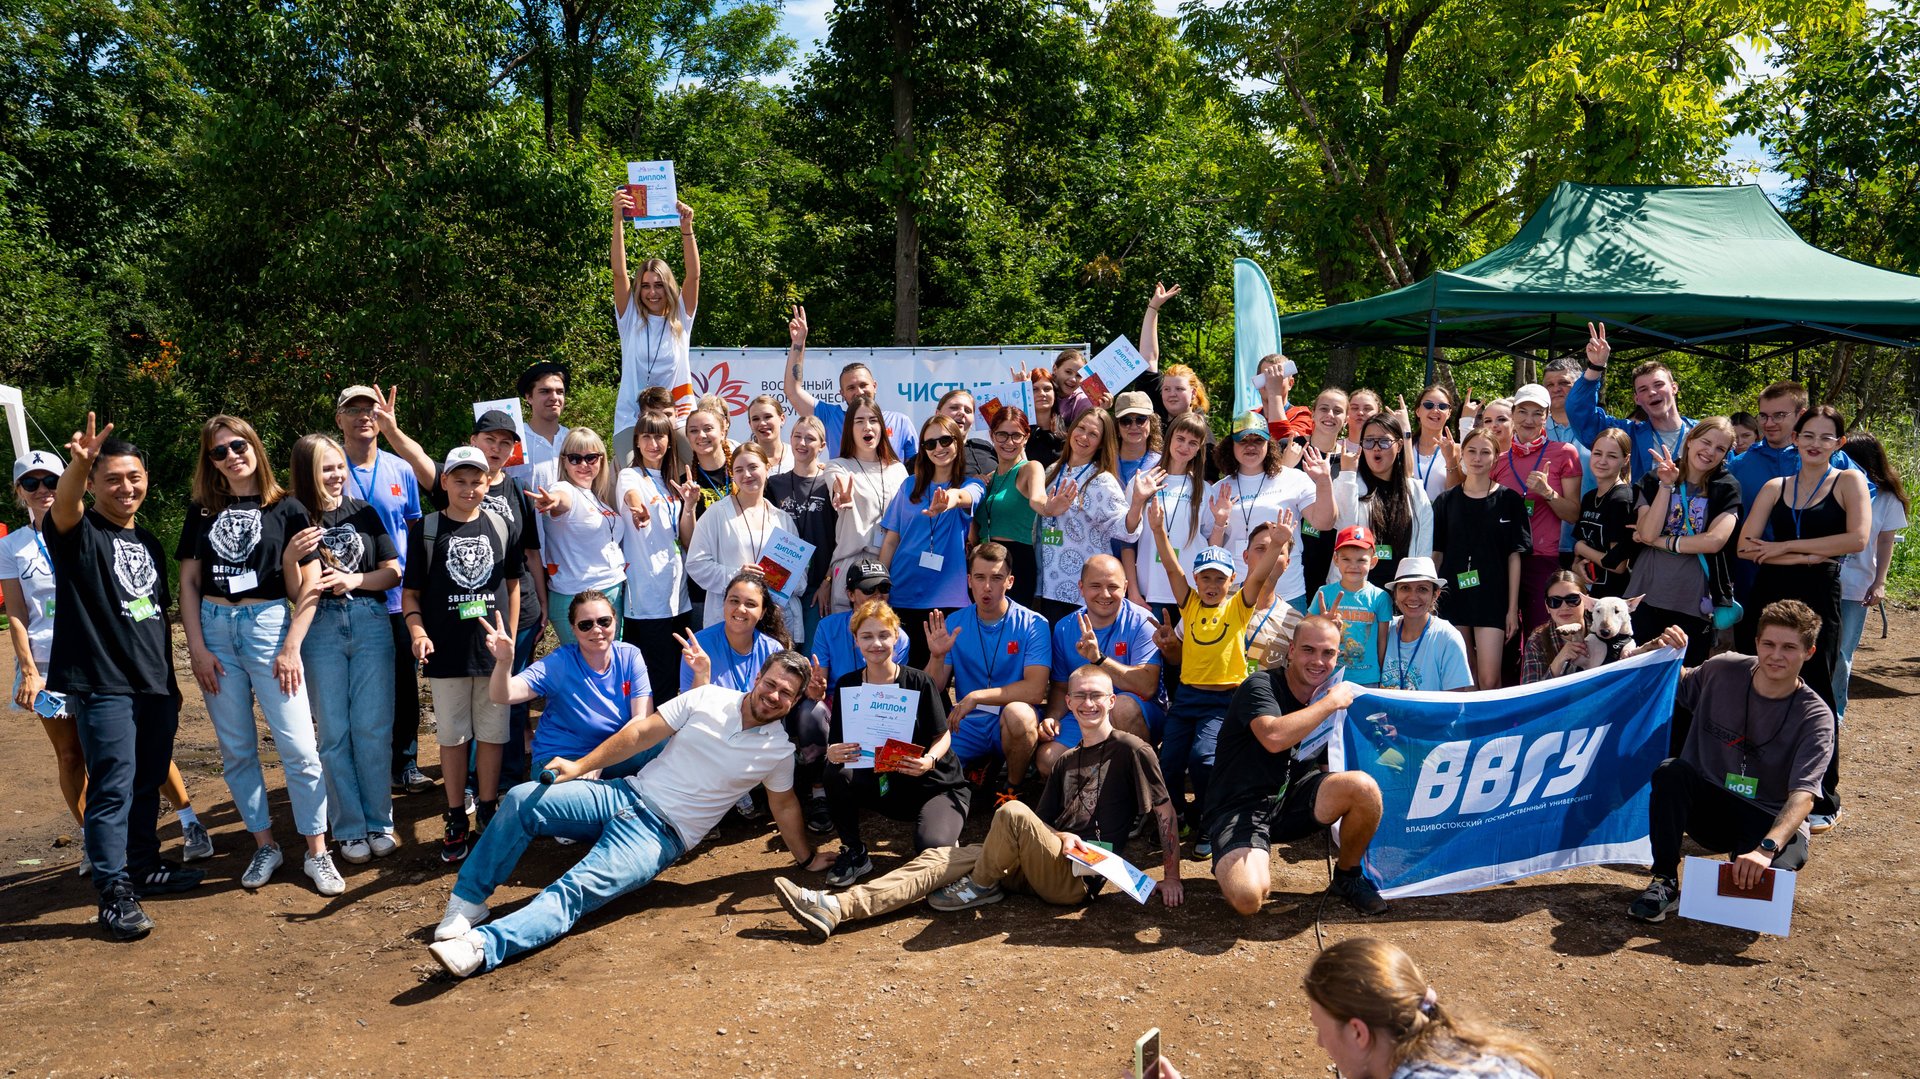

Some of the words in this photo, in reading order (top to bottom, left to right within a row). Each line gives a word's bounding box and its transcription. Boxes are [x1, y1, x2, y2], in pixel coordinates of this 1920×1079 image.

[638, 174, 667, 182] ДИПЛОМ
[1115, 348, 1136, 371] ДИПЛОМ
[761, 379, 833, 391] ВОСЧНЫЙ
[774, 542, 802, 561] ДИПЛОМ
[1201, 549, 1226, 562] TAKE
[448, 593, 496, 603] SBERTEAM
[869, 701, 907, 713] ДИПЛОМ
[1406, 722, 1613, 820] ВВГУ
[1405, 819, 1483, 833] ВЛАДИВОСТОКСКИЙ
[1484, 801, 1547, 824] ГОСУДАРСТВЕННЫЙ
[1549, 793, 1593, 807] УНИВЕРСИТЕТ
